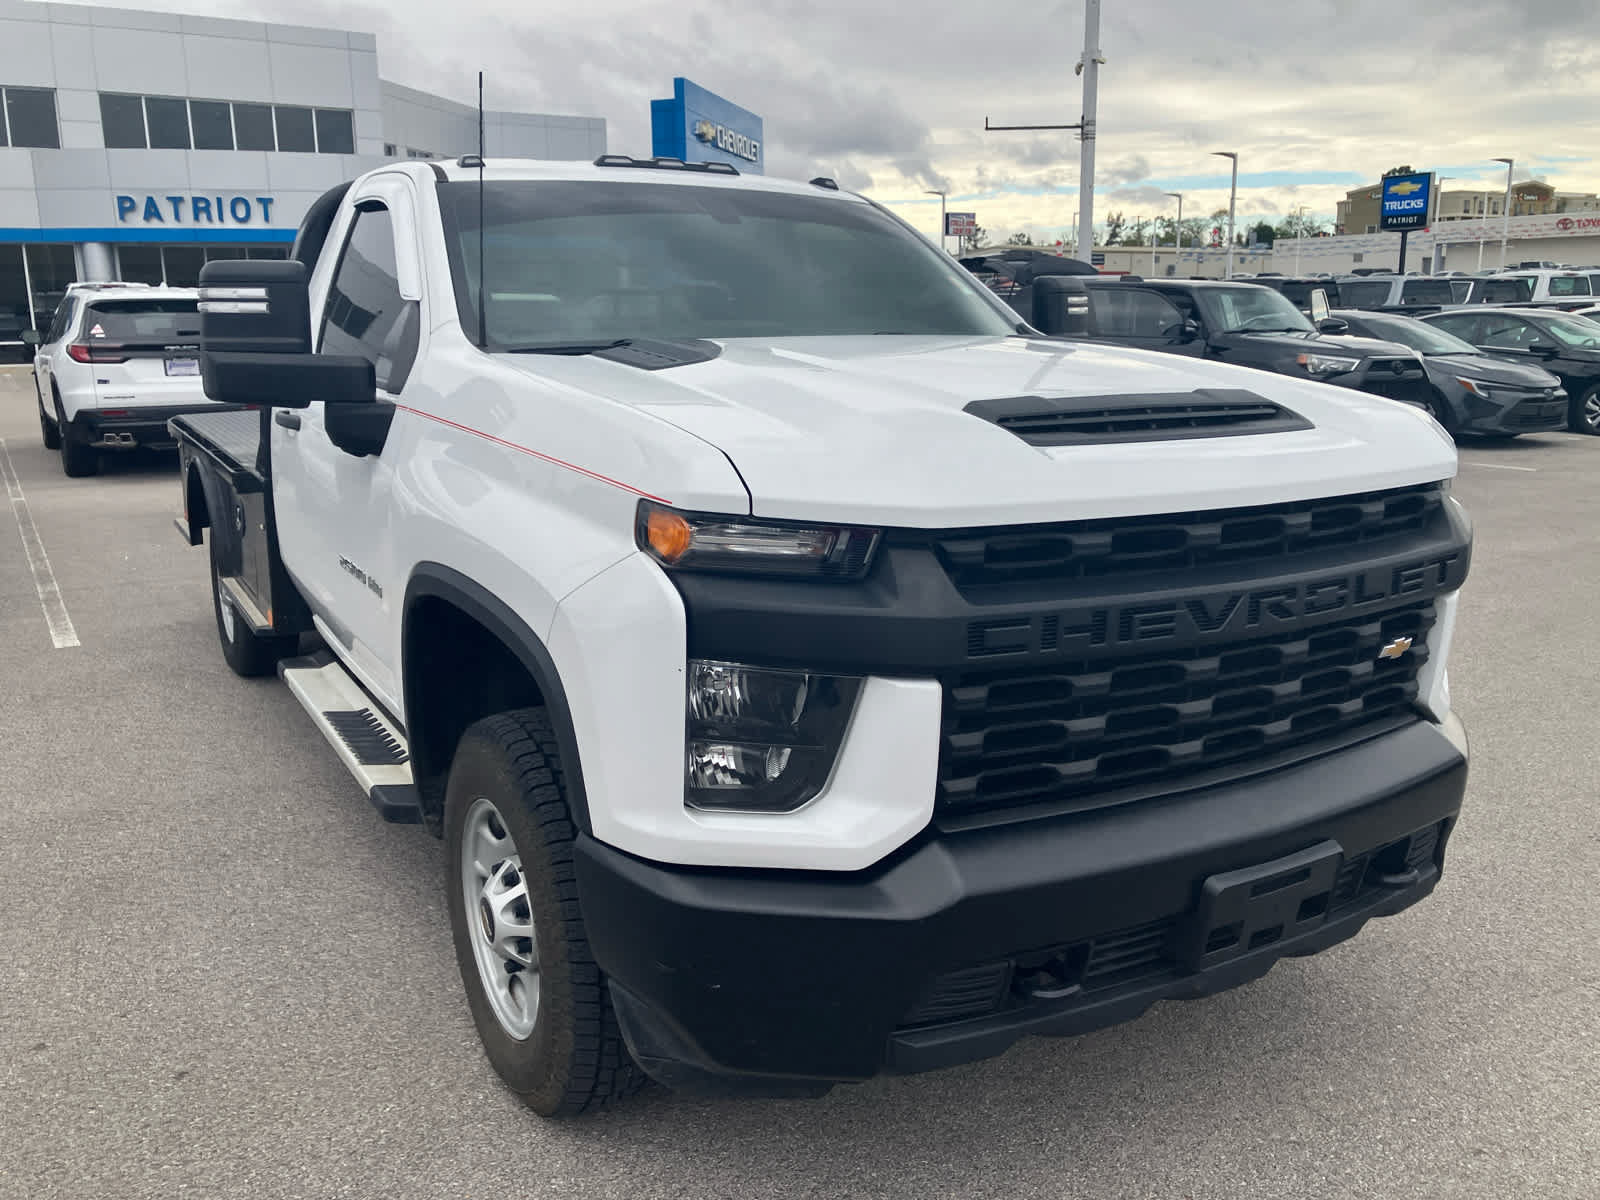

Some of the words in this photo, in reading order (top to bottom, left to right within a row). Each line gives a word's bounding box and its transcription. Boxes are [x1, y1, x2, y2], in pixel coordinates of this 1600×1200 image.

[717, 125, 760, 161] CHEVROLET
[116, 195, 274, 223] PATRIOT
[1384, 199, 1424, 211] TRUCKS
[1387, 216, 1418, 224] PATRIOT
[966, 554, 1458, 659] CHEVROLET
